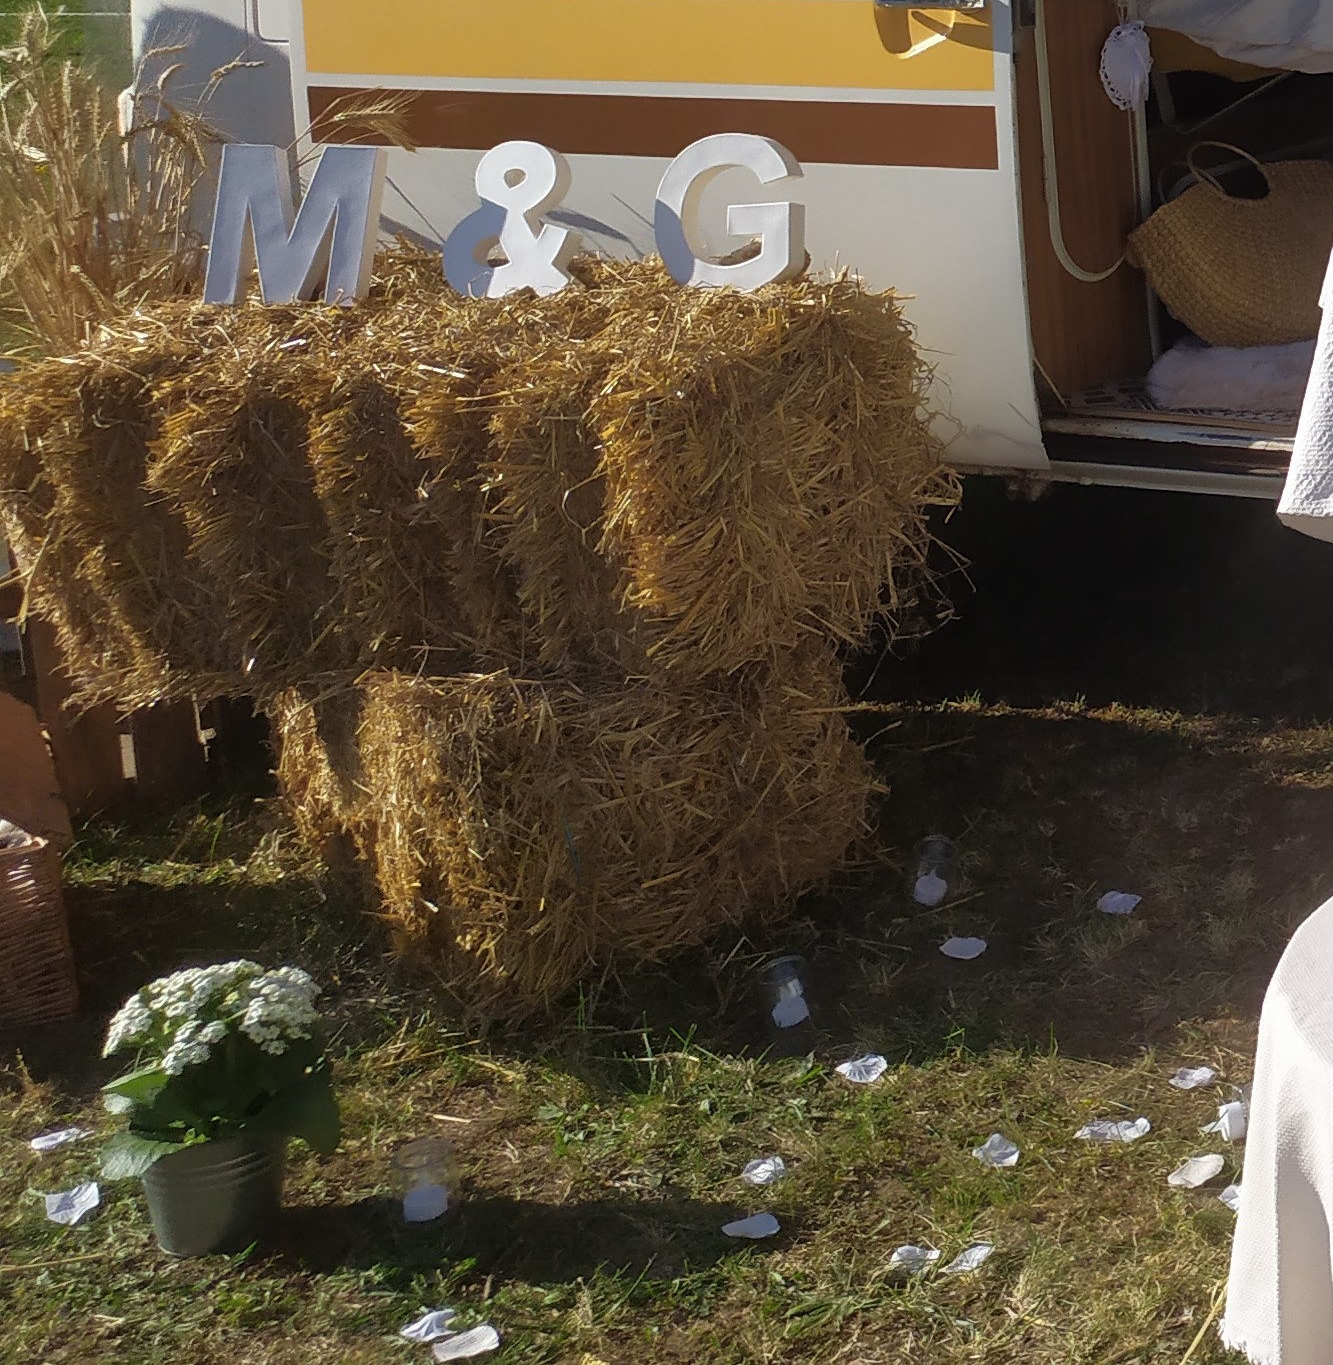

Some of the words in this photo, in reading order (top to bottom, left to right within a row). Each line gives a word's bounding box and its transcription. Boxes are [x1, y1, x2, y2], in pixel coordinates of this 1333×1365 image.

[203, 143, 388, 307] M
[442, 140, 578, 299] &
[653, 132, 805, 294] G
